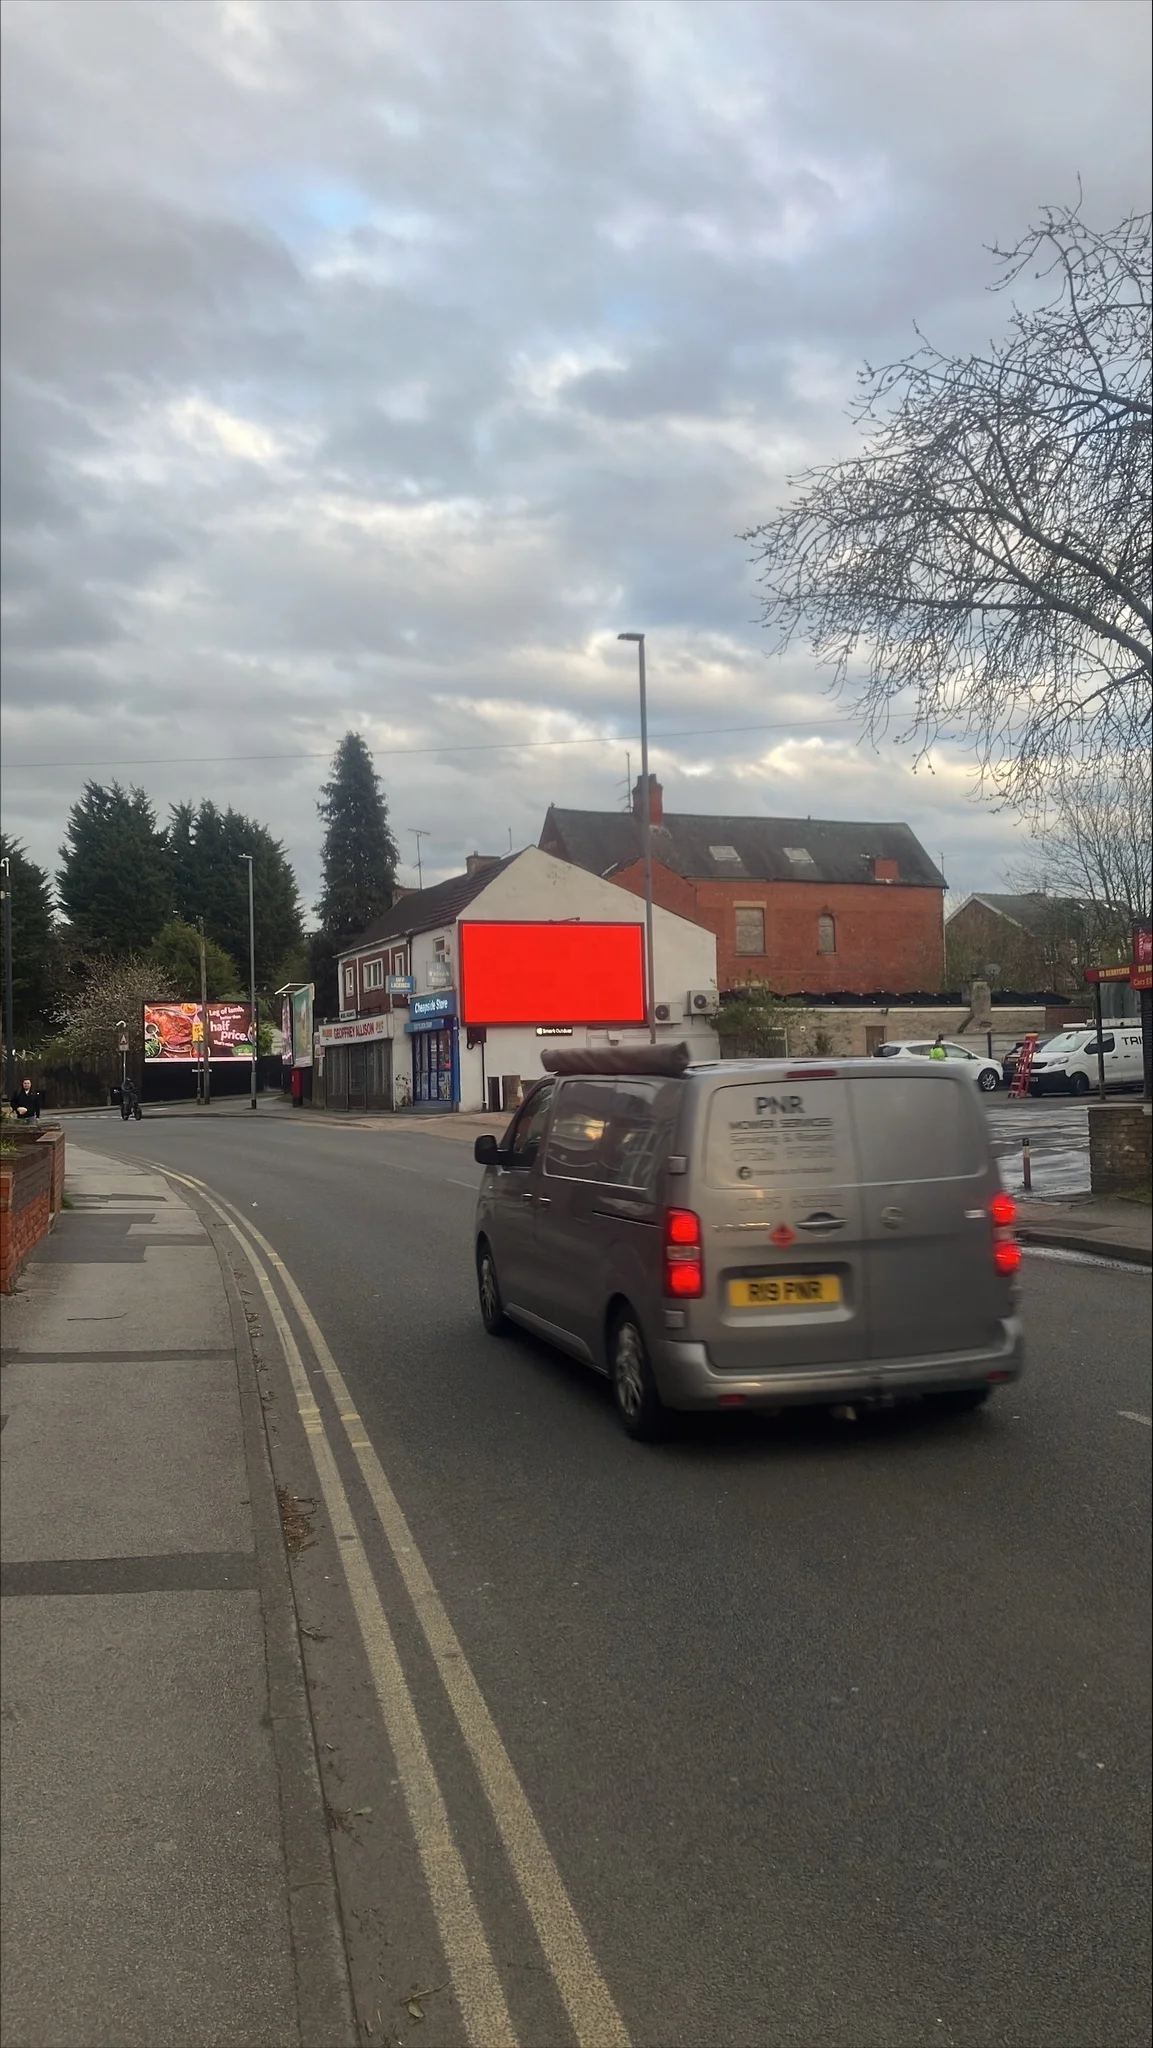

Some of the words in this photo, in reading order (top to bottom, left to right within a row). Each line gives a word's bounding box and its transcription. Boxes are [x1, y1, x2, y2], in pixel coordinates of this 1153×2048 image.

[208, 1009, 220, 1017] Leg
[220, 1007, 228, 1015] of
[414, 1001, 436, 1014] Cheapside
[436, 998, 448, 1010] Store
[210, 1020, 230, 1032] half
[333, 1026, 355, 1039] GEOFFREY
[355, 1022, 375, 1037] ALLISON
[220, 1029, 248, 1042] price.
[1121, 1036, 1143, 1046] TRI
[755, 1095, 806, 1115] PNR
[748, 1282, 780, 1302] R19
[783, 1281, 822, 1300] PNR
